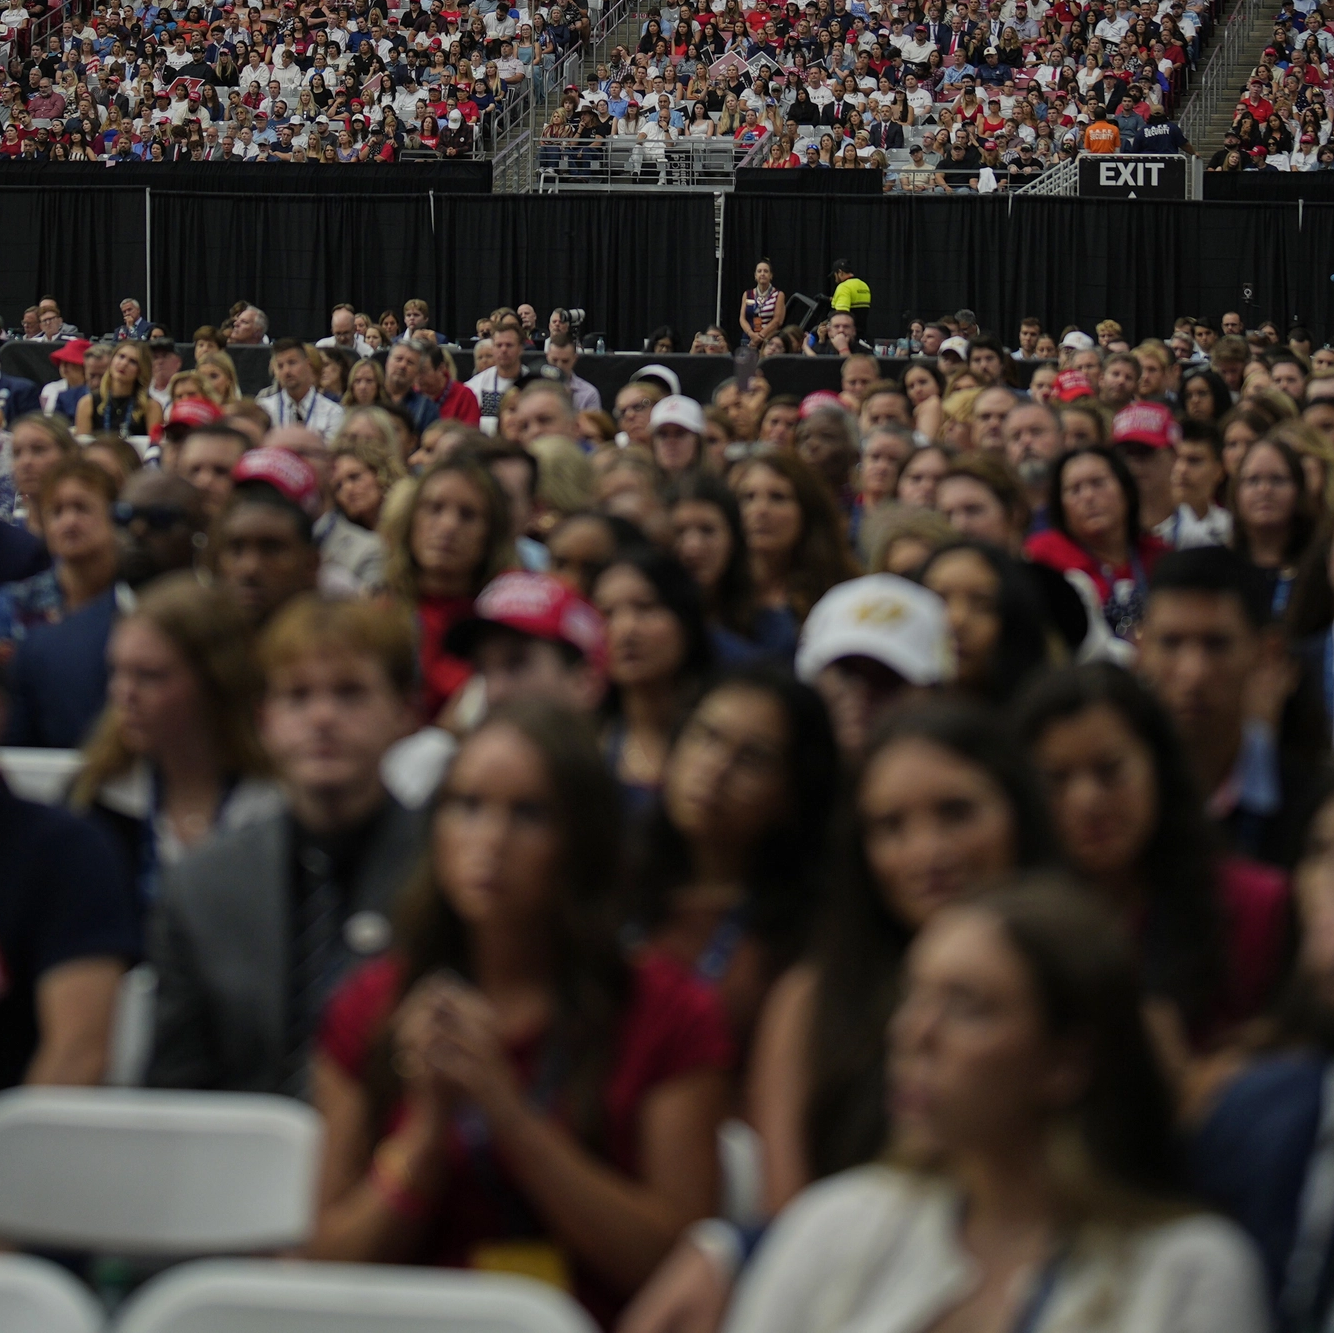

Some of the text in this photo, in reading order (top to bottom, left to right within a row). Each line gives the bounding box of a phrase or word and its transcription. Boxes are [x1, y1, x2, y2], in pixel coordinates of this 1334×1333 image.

[1089, 133, 1114, 141] SECURITY
[1144, 127, 1170, 138] SECURITY
[1100, 162, 1165, 186] EXIT
